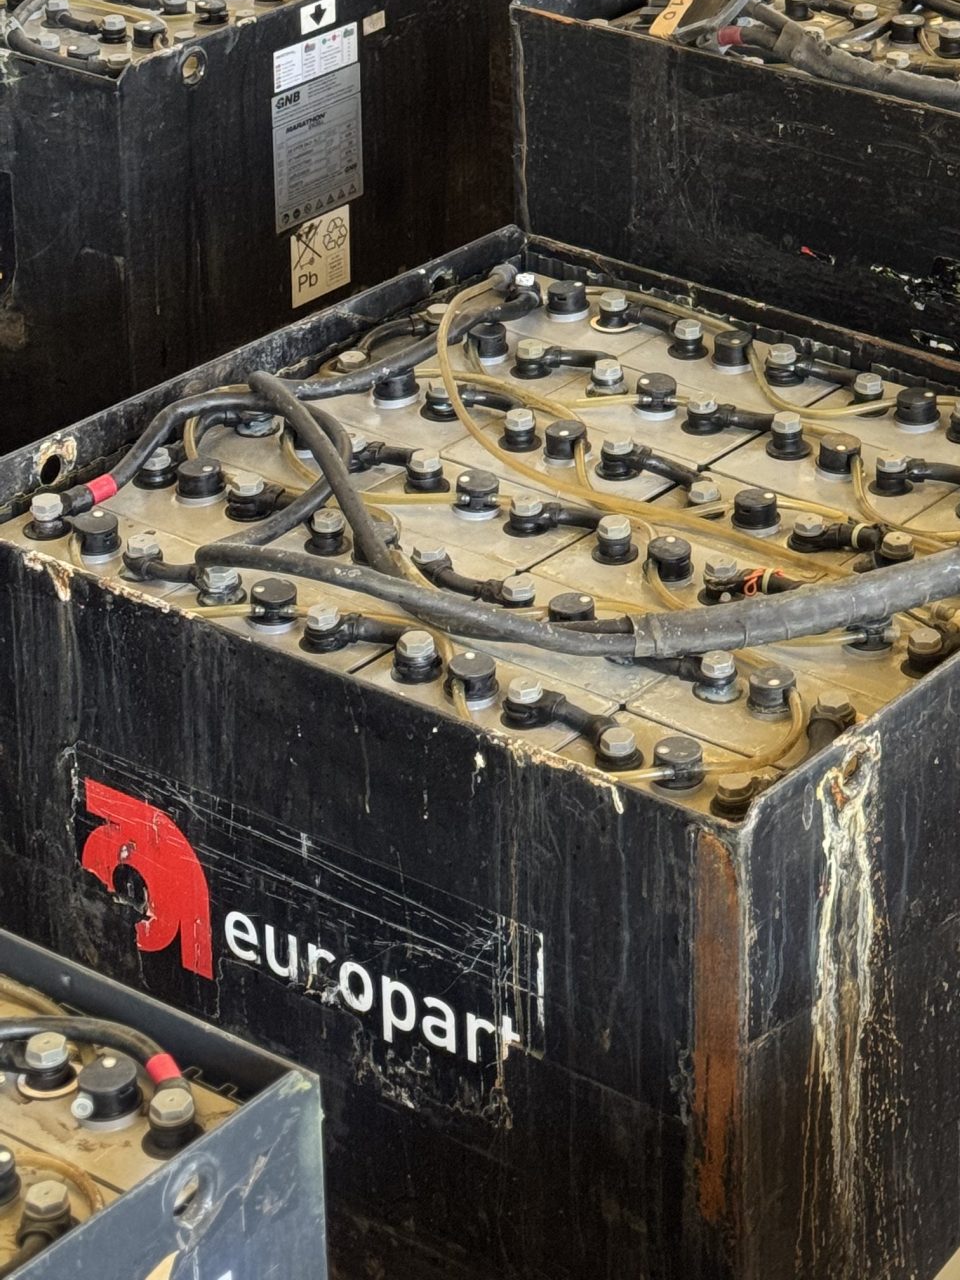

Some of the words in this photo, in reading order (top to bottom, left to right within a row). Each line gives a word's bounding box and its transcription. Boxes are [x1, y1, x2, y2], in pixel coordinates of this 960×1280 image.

[275, 91, 301, 110] GNB
[285, 111, 327, 134] MARATHON
[298, 272, 319, 294] Pb
[223, 909, 520, 1064] europart
